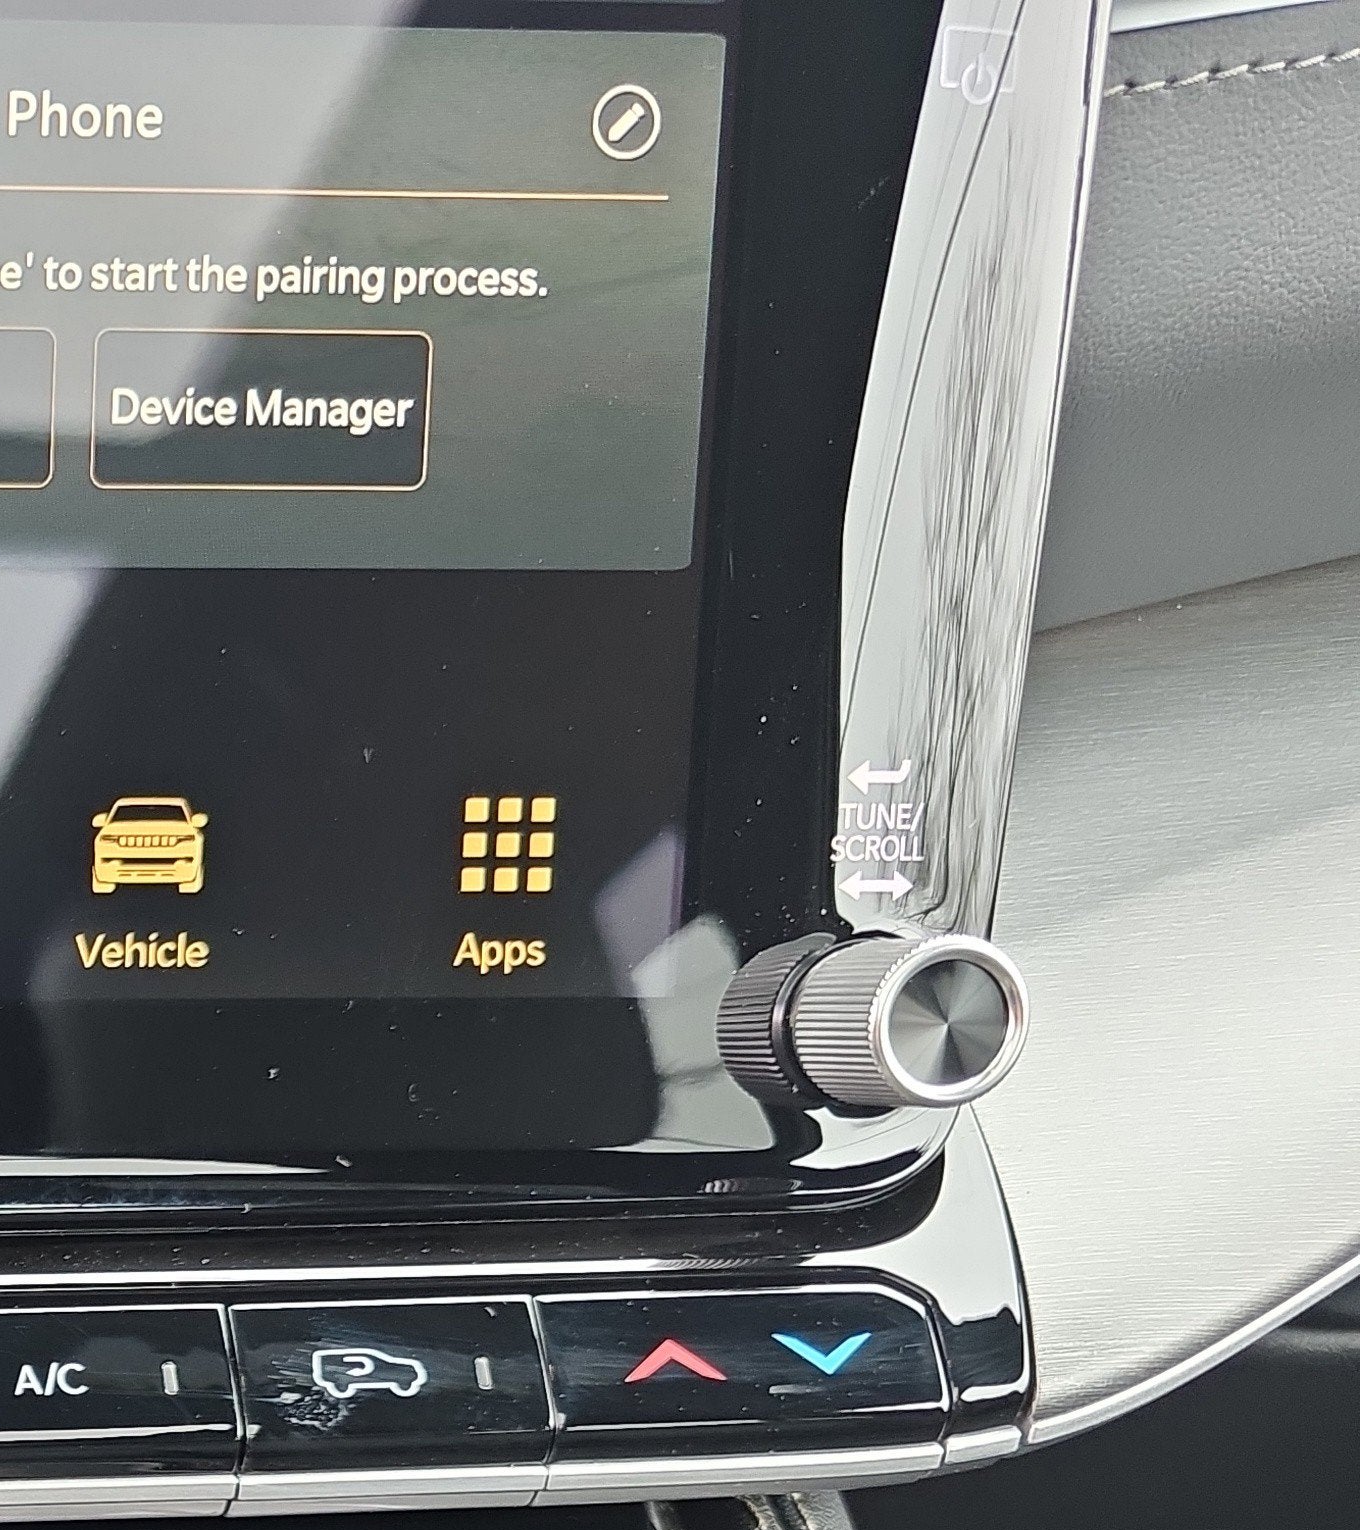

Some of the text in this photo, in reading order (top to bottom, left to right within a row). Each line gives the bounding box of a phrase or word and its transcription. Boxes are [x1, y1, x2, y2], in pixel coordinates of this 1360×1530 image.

[7, 88, 164, 139] Phone
[43, 256, 81, 291] to
[89, 256, 178, 292] start
[186, 254, 247, 294] the
[256, 256, 385, 303] pairing
[393, 265, 548, 304] process.
[110, 387, 416, 436] Device Manager
[839, 802, 926, 832] TUNE/
[829, 834, 925, 862] SCROLL
[74, 930, 211, 969] Vehicle
[452, 932, 548, 976] Apps
[13, 1362, 90, 1396] A/C
